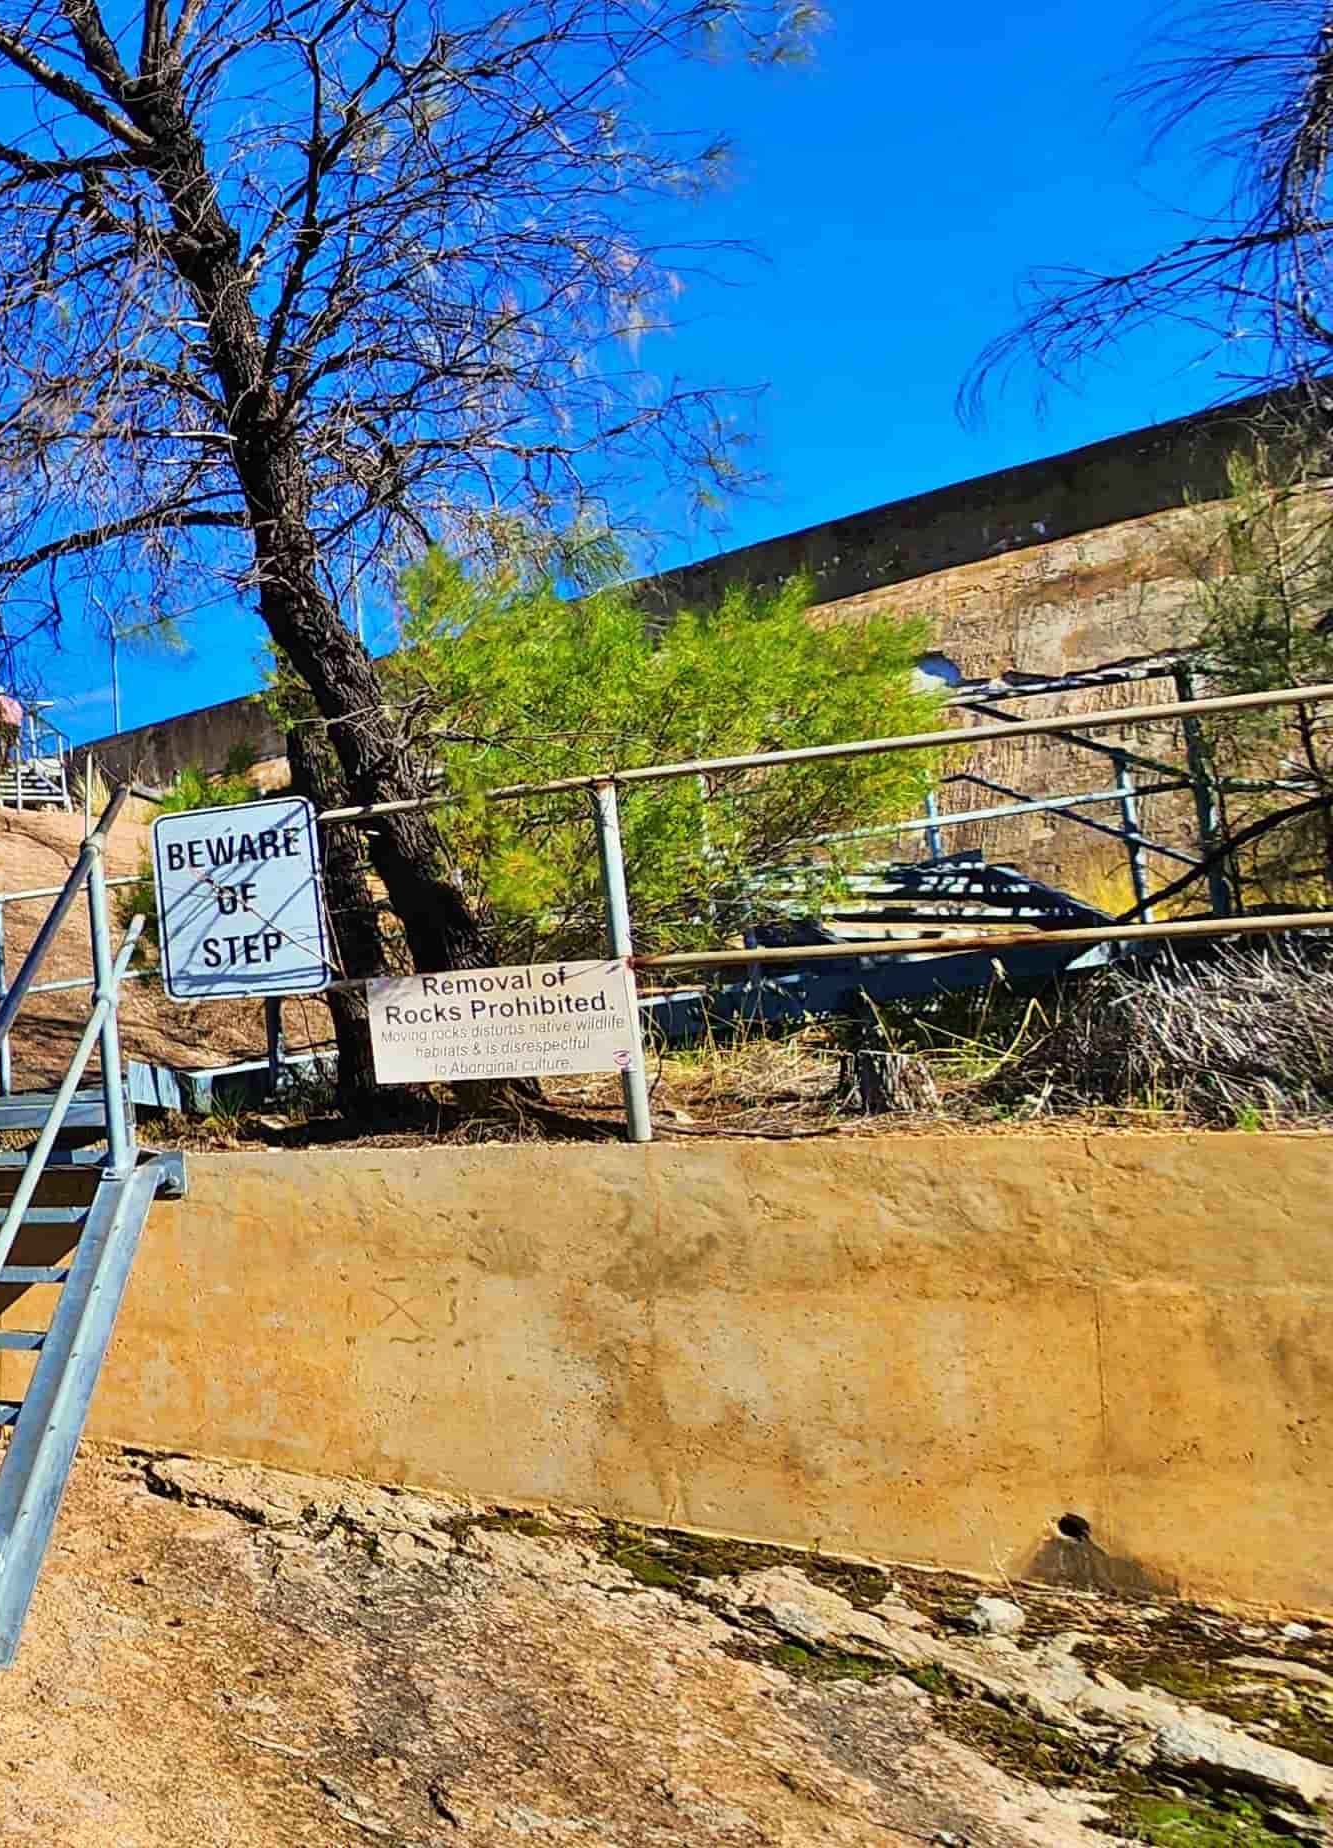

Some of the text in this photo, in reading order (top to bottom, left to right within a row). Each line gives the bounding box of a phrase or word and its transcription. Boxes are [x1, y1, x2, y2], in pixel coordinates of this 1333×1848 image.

[166, 827, 301, 871] BEWARE
[218, 882, 257, 915] OF
[202, 932, 282, 967] STEP
[422, 966, 566, 996] Removal of
[385, 991, 615, 1025] Rocks Prohibited.
[382, 1015, 625, 1044] Moving rocks disturbs native wildlife
[416, 1037, 590, 1058] habitats & is disrespectful
[434, 1057, 573, 1076] to Aboriginal culture.
